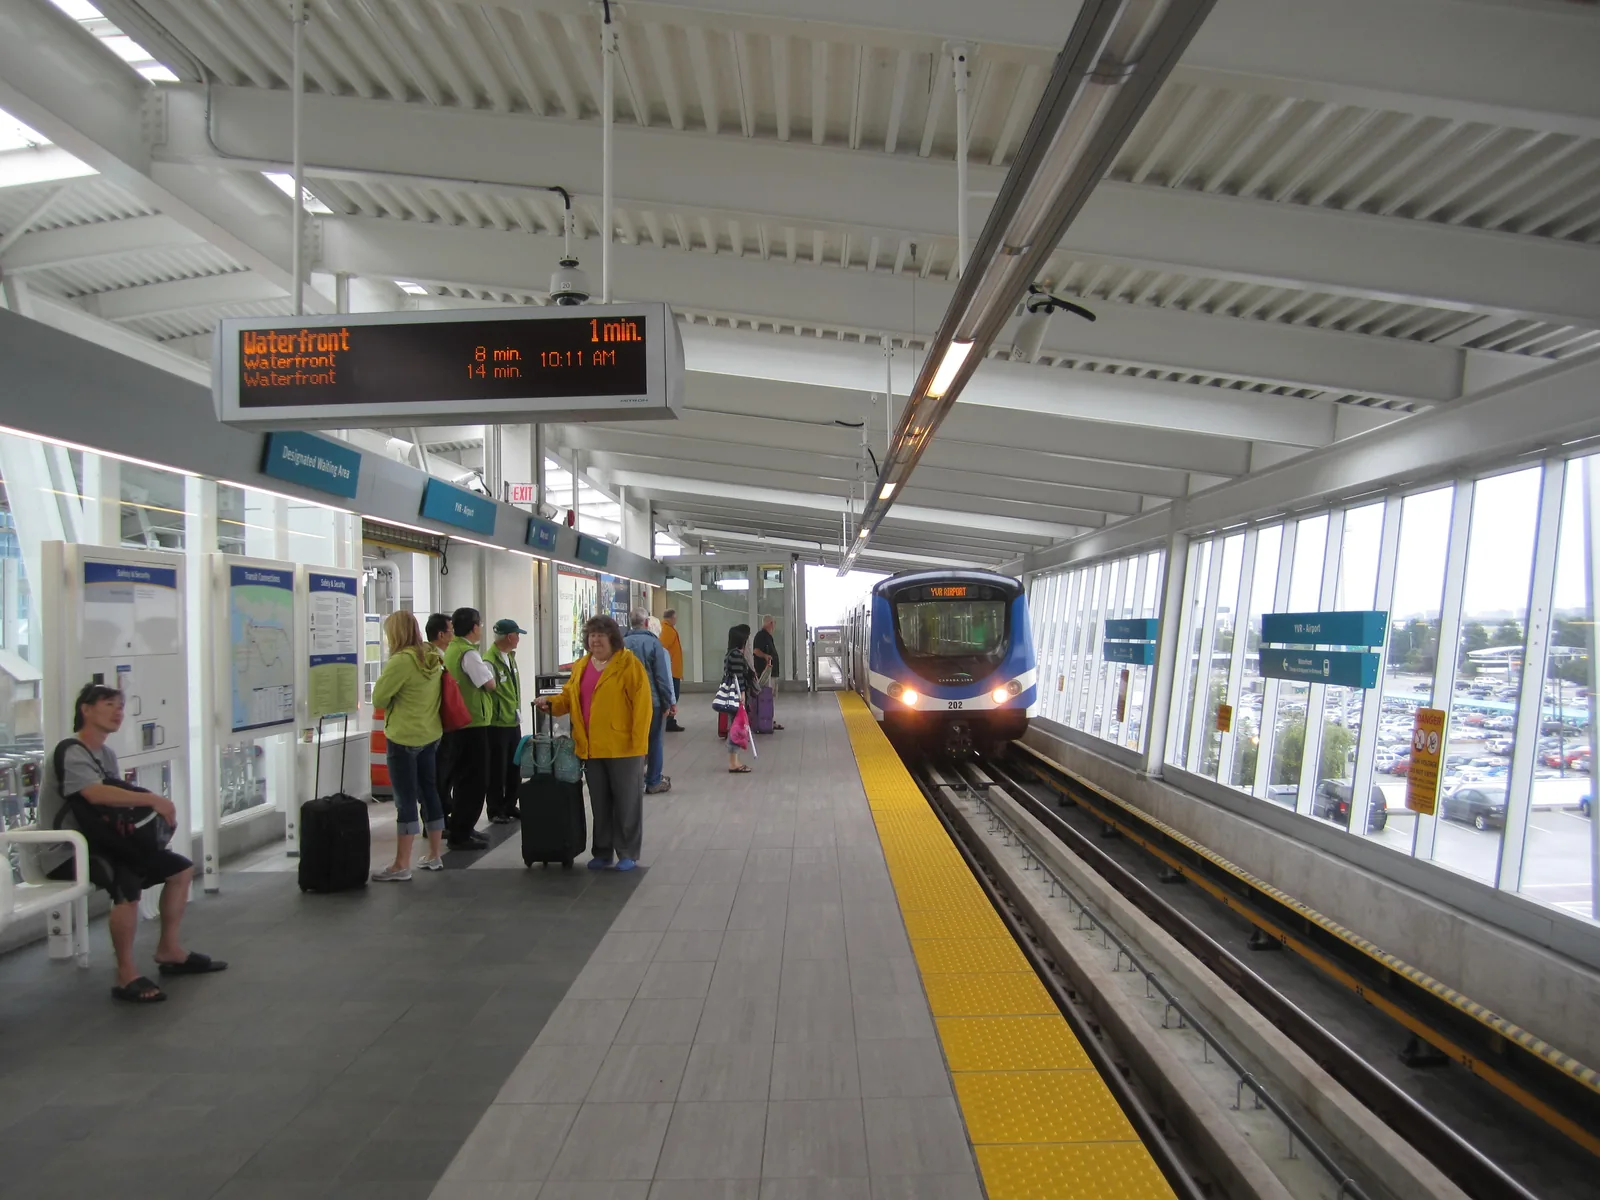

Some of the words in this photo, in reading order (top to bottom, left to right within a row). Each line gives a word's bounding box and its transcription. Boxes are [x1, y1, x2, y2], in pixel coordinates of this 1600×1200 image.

[243, 327, 350, 354] Waterfront
[590, 318, 599, 342] 1
[603, 318, 642, 342] min.
[243, 352, 336, 370] Waterfront
[475, 346, 486, 361] 8
[493, 346, 522, 361] min.
[541, 351, 583, 367] 10:11
[593, 350, 615, 366] AM
[243, 369, 336, 386] Waterfront
[467, 364, 486, 379] 14
[494, 364, 523, 379] min.
[282, 445, 317, 468] Designated
[317, 457, 338, 478] Waiting
[338, 465, 350, 479] Area
[513, 486, 533, 501] EXIT
[244, 571, 257, 580] Transit
[258, 572, 280, 583] Connections
[320, 578, 331, 589] Safety
[333, 580, 346, 591] Security
[943, 586, 967, 597] AIRPORT
[1294, 624, 1302, 633] YVR
[1305, 624, 1321, 635] Airport
[948, 701, 963, 709] 202
[1416, 713, 1442, 726] DANGER
